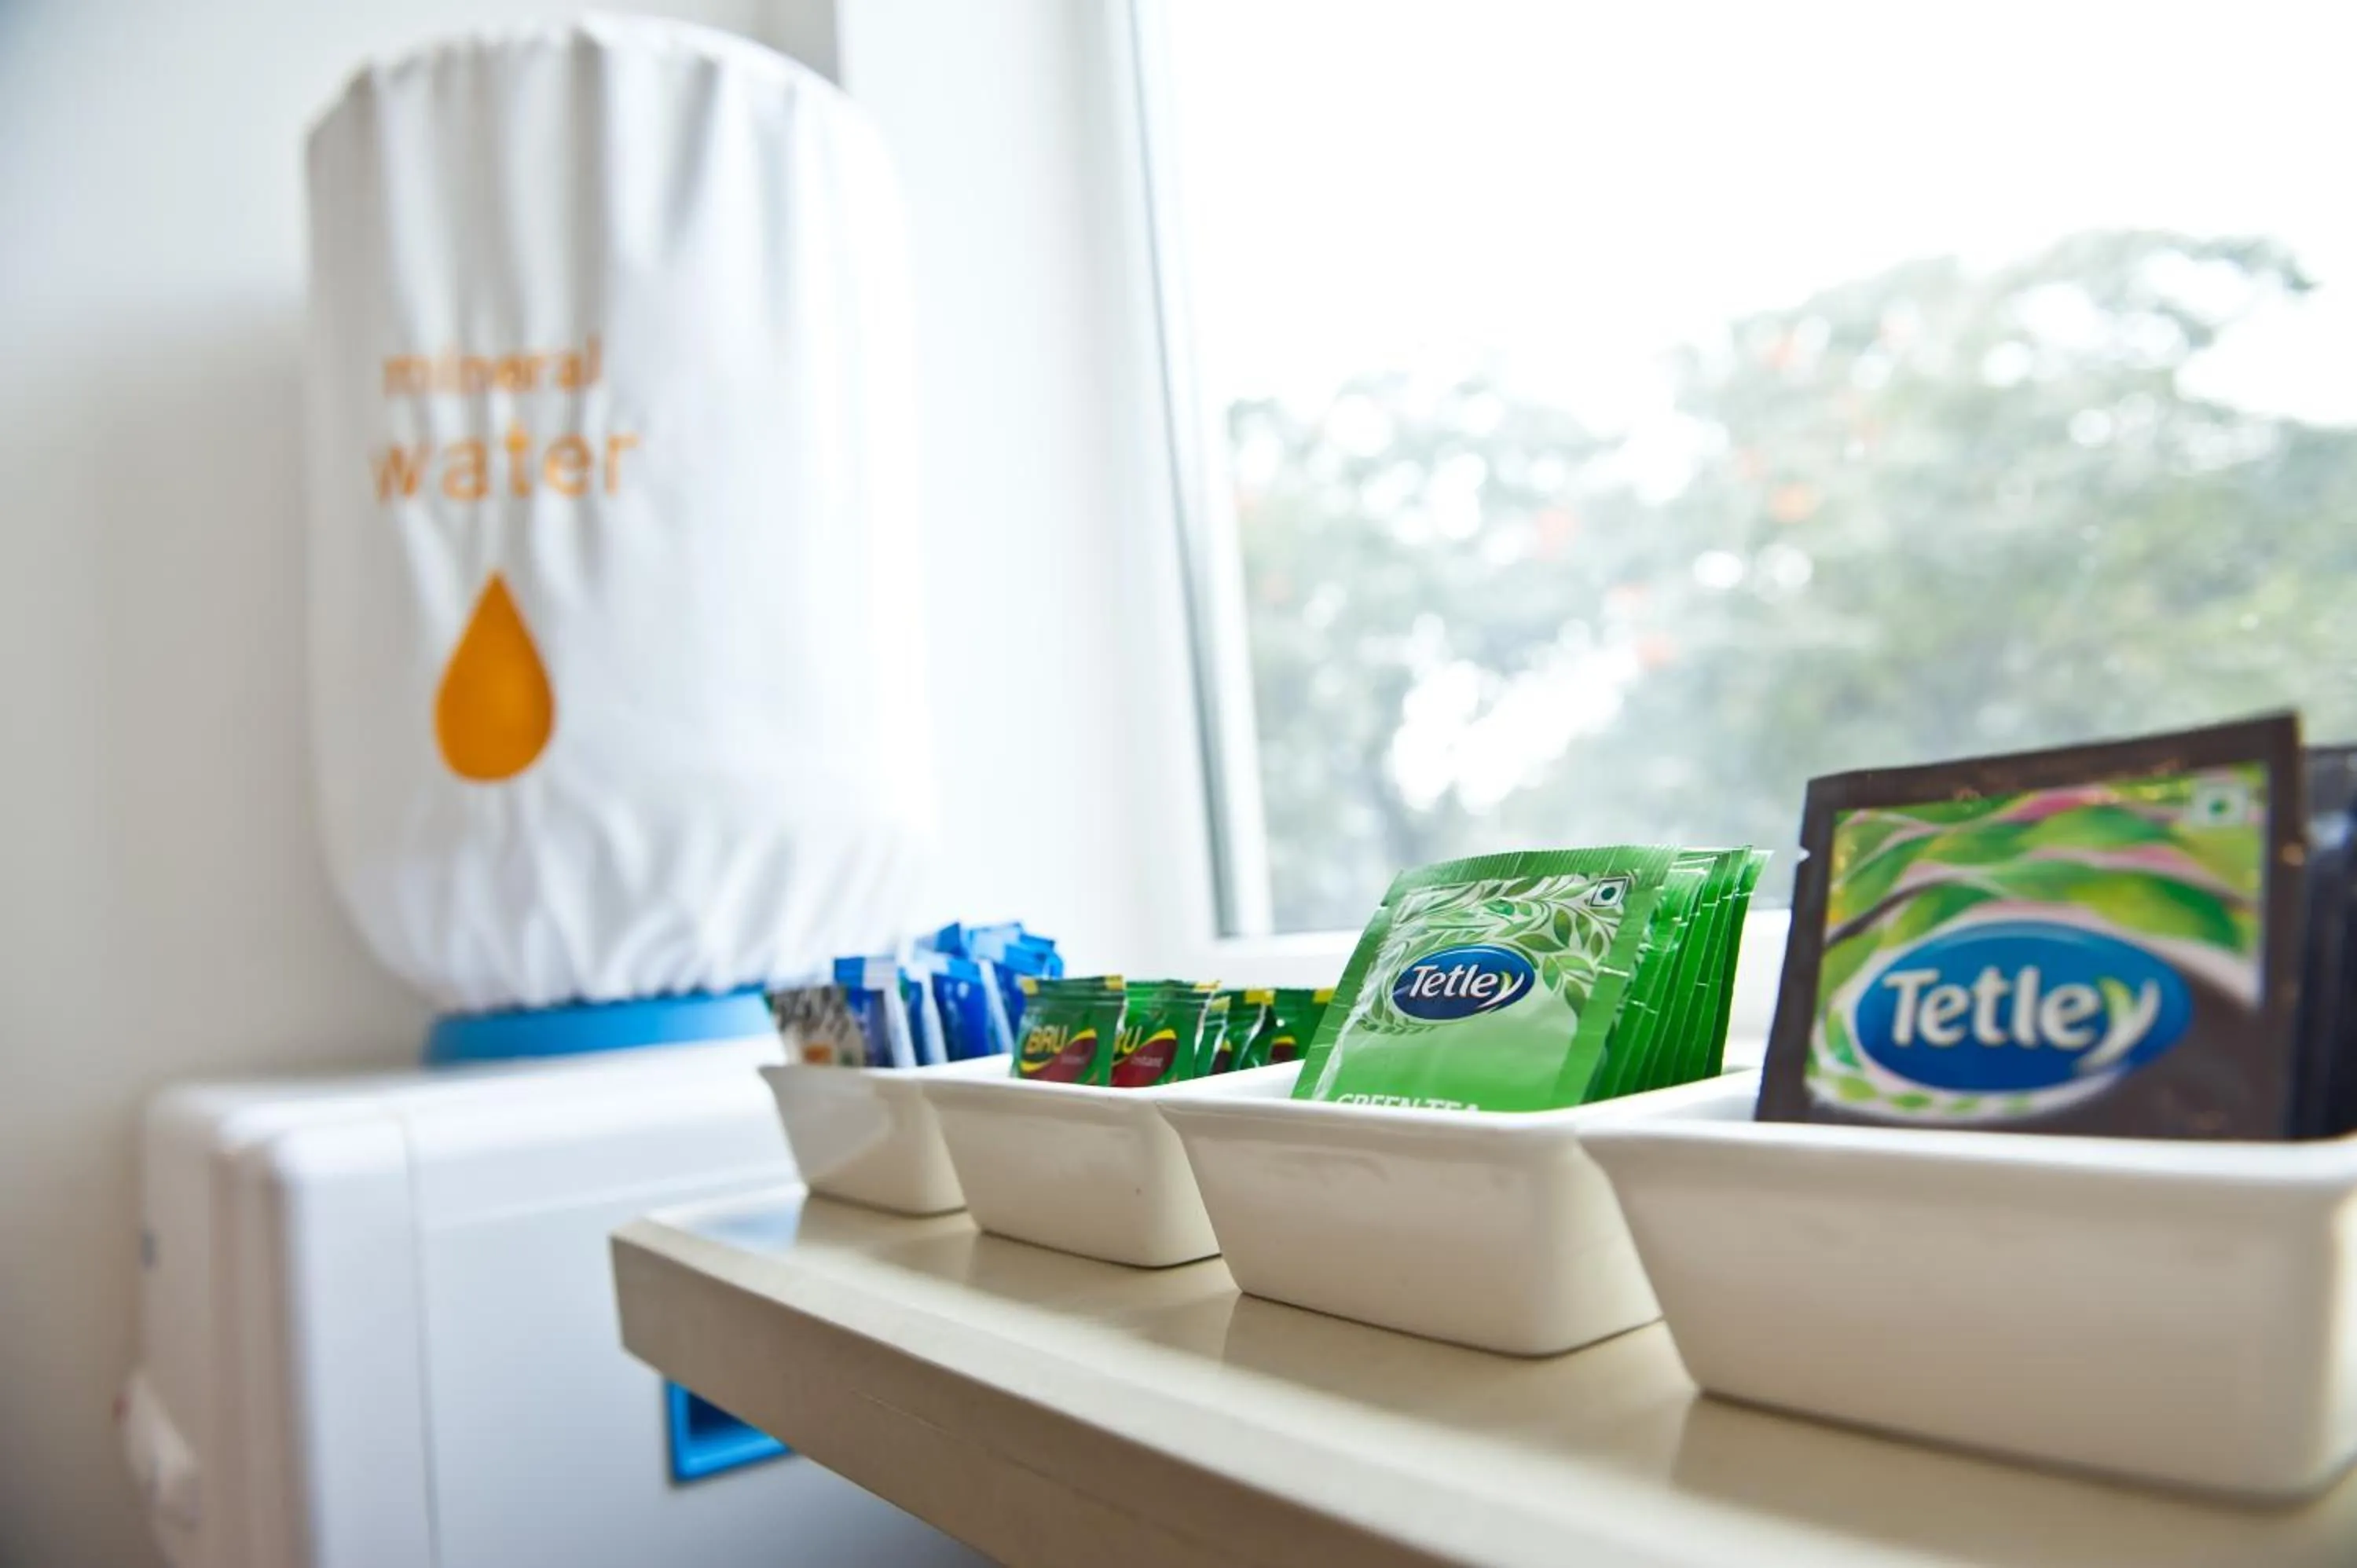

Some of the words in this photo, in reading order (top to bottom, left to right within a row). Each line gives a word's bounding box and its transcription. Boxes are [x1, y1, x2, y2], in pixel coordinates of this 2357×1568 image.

[368, 419, 640, 504] water
[1409, 964, 1525, 1009] Tetley
[1882, 965, 2161, 1073] Tetley
